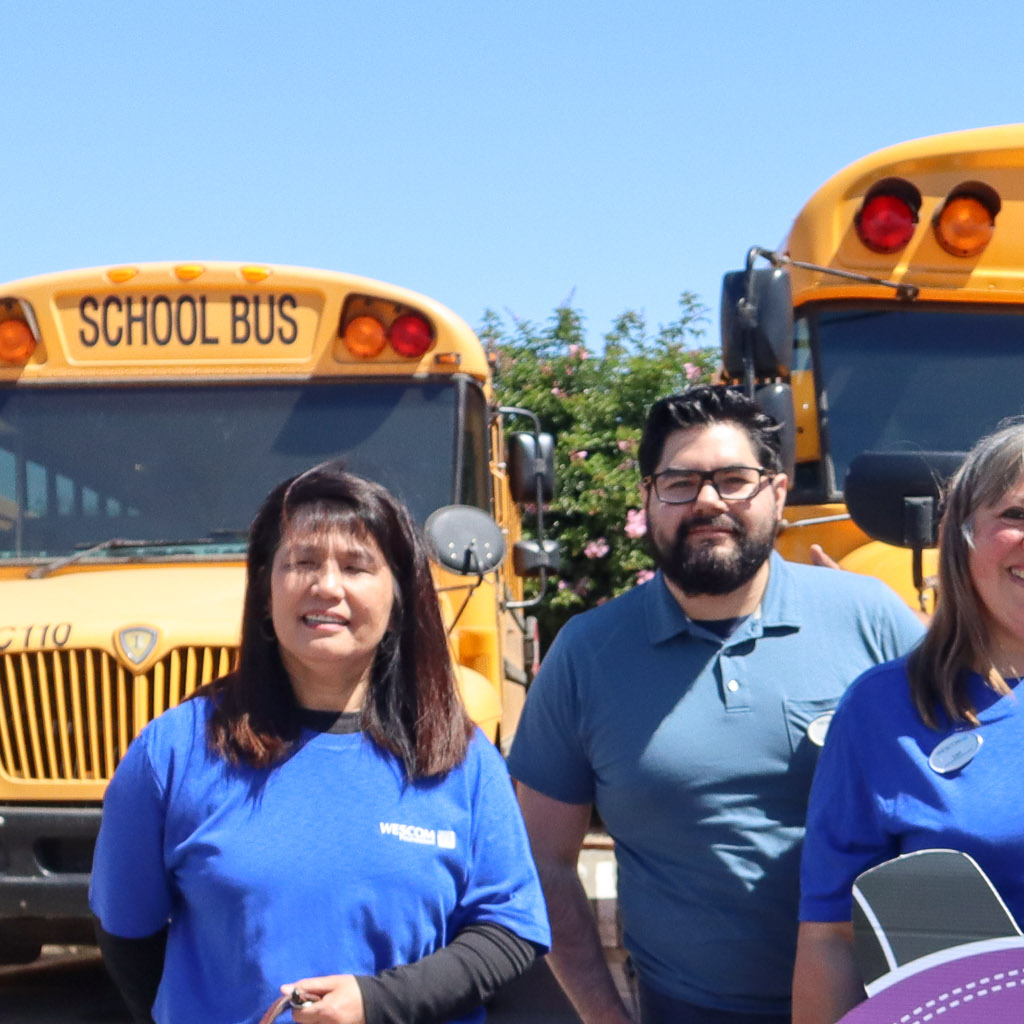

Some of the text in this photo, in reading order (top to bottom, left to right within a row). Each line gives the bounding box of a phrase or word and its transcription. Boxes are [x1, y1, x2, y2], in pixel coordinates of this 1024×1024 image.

[79, 294, 298, 347] SCHOOL BUS
[380, 822, 436, 841] WESCOM
